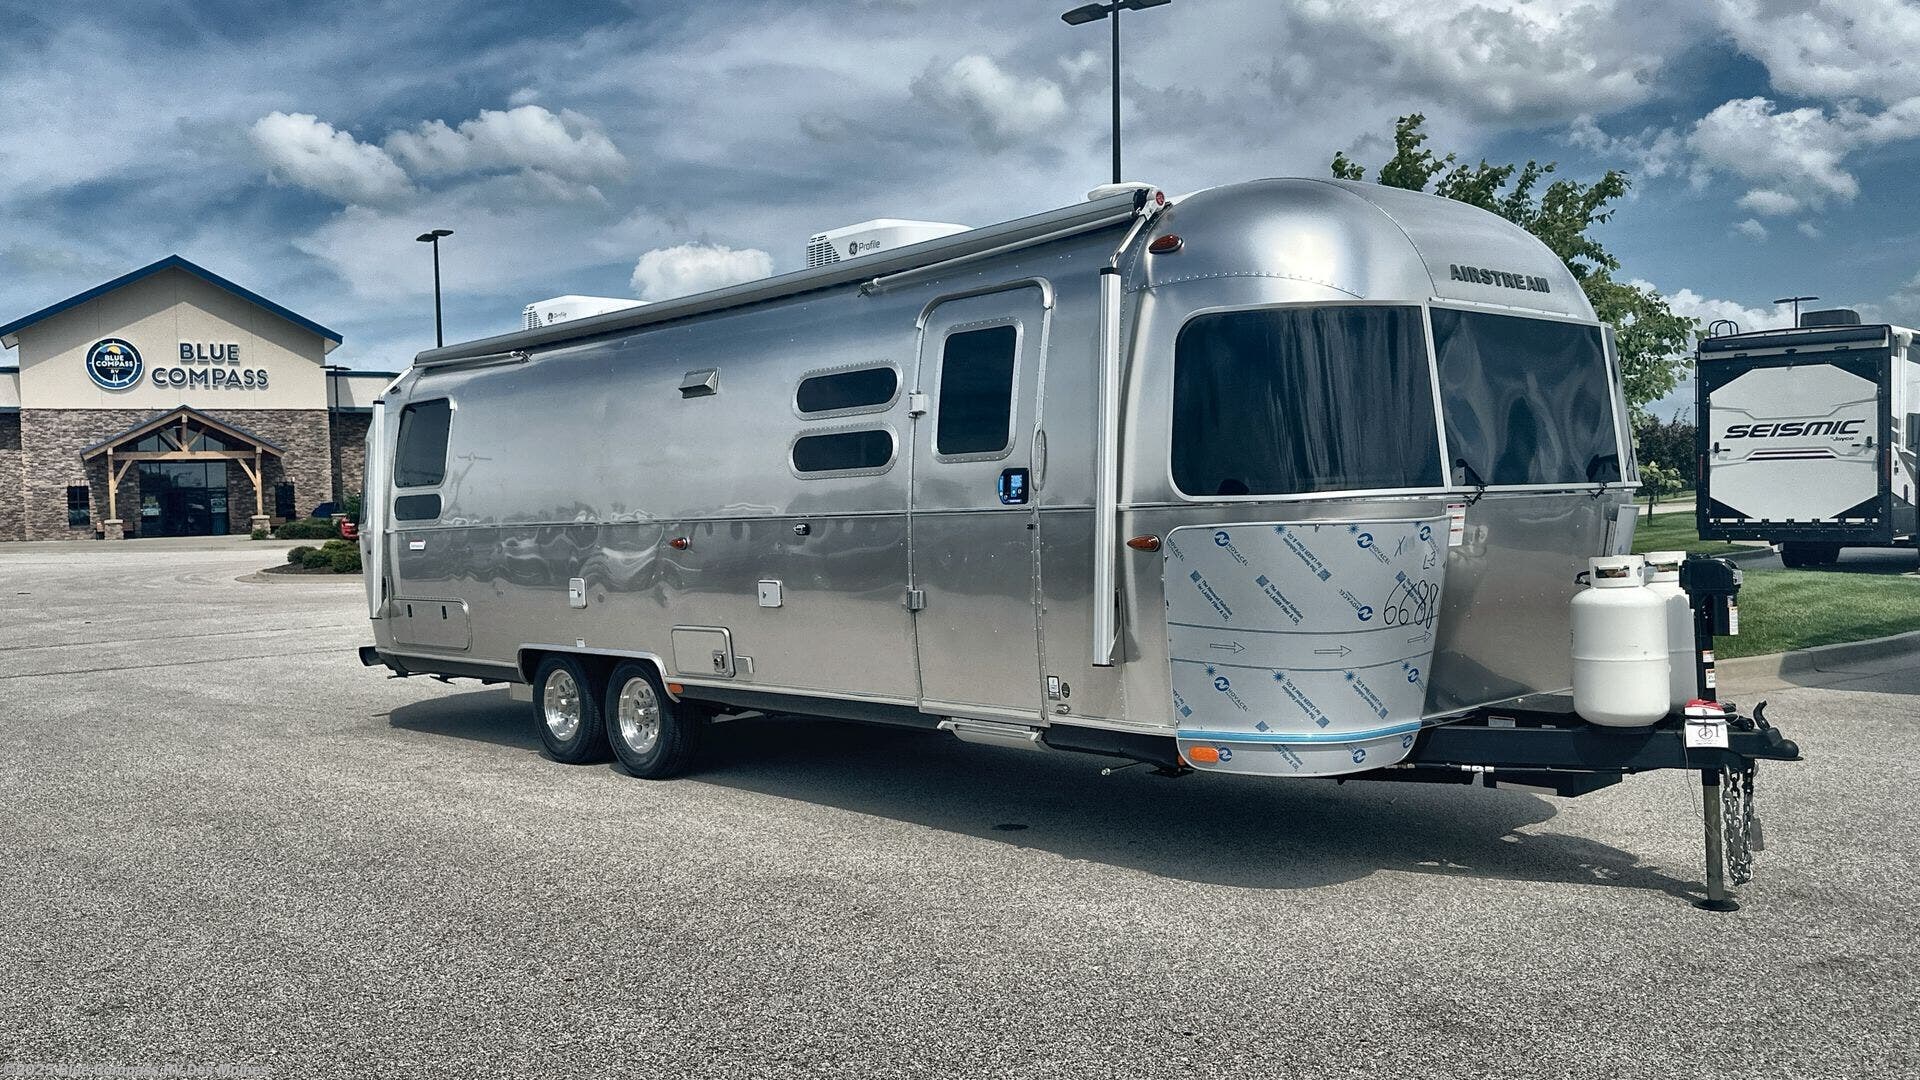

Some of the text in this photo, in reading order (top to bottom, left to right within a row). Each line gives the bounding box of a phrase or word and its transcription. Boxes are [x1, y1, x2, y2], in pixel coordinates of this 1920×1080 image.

[859, 240, 880, 251] Profile
[1450, 264, 1550, 293] AIRSTREAM
[180, 343, 240, 362] BLUE
[152, 368, 268, 387] COMPASS
[1724, 419, 1866, 439] SEISMIC
[1226, 542, 1249, 566] NOVACEL
[1370, 543, 1391, 565] NOVACEL
[1337, 588, 1360, 610] NOVACEL
[1384, 580, 1439, 629] 6688
[1226, 687, 1249, 711] NOVACEL
